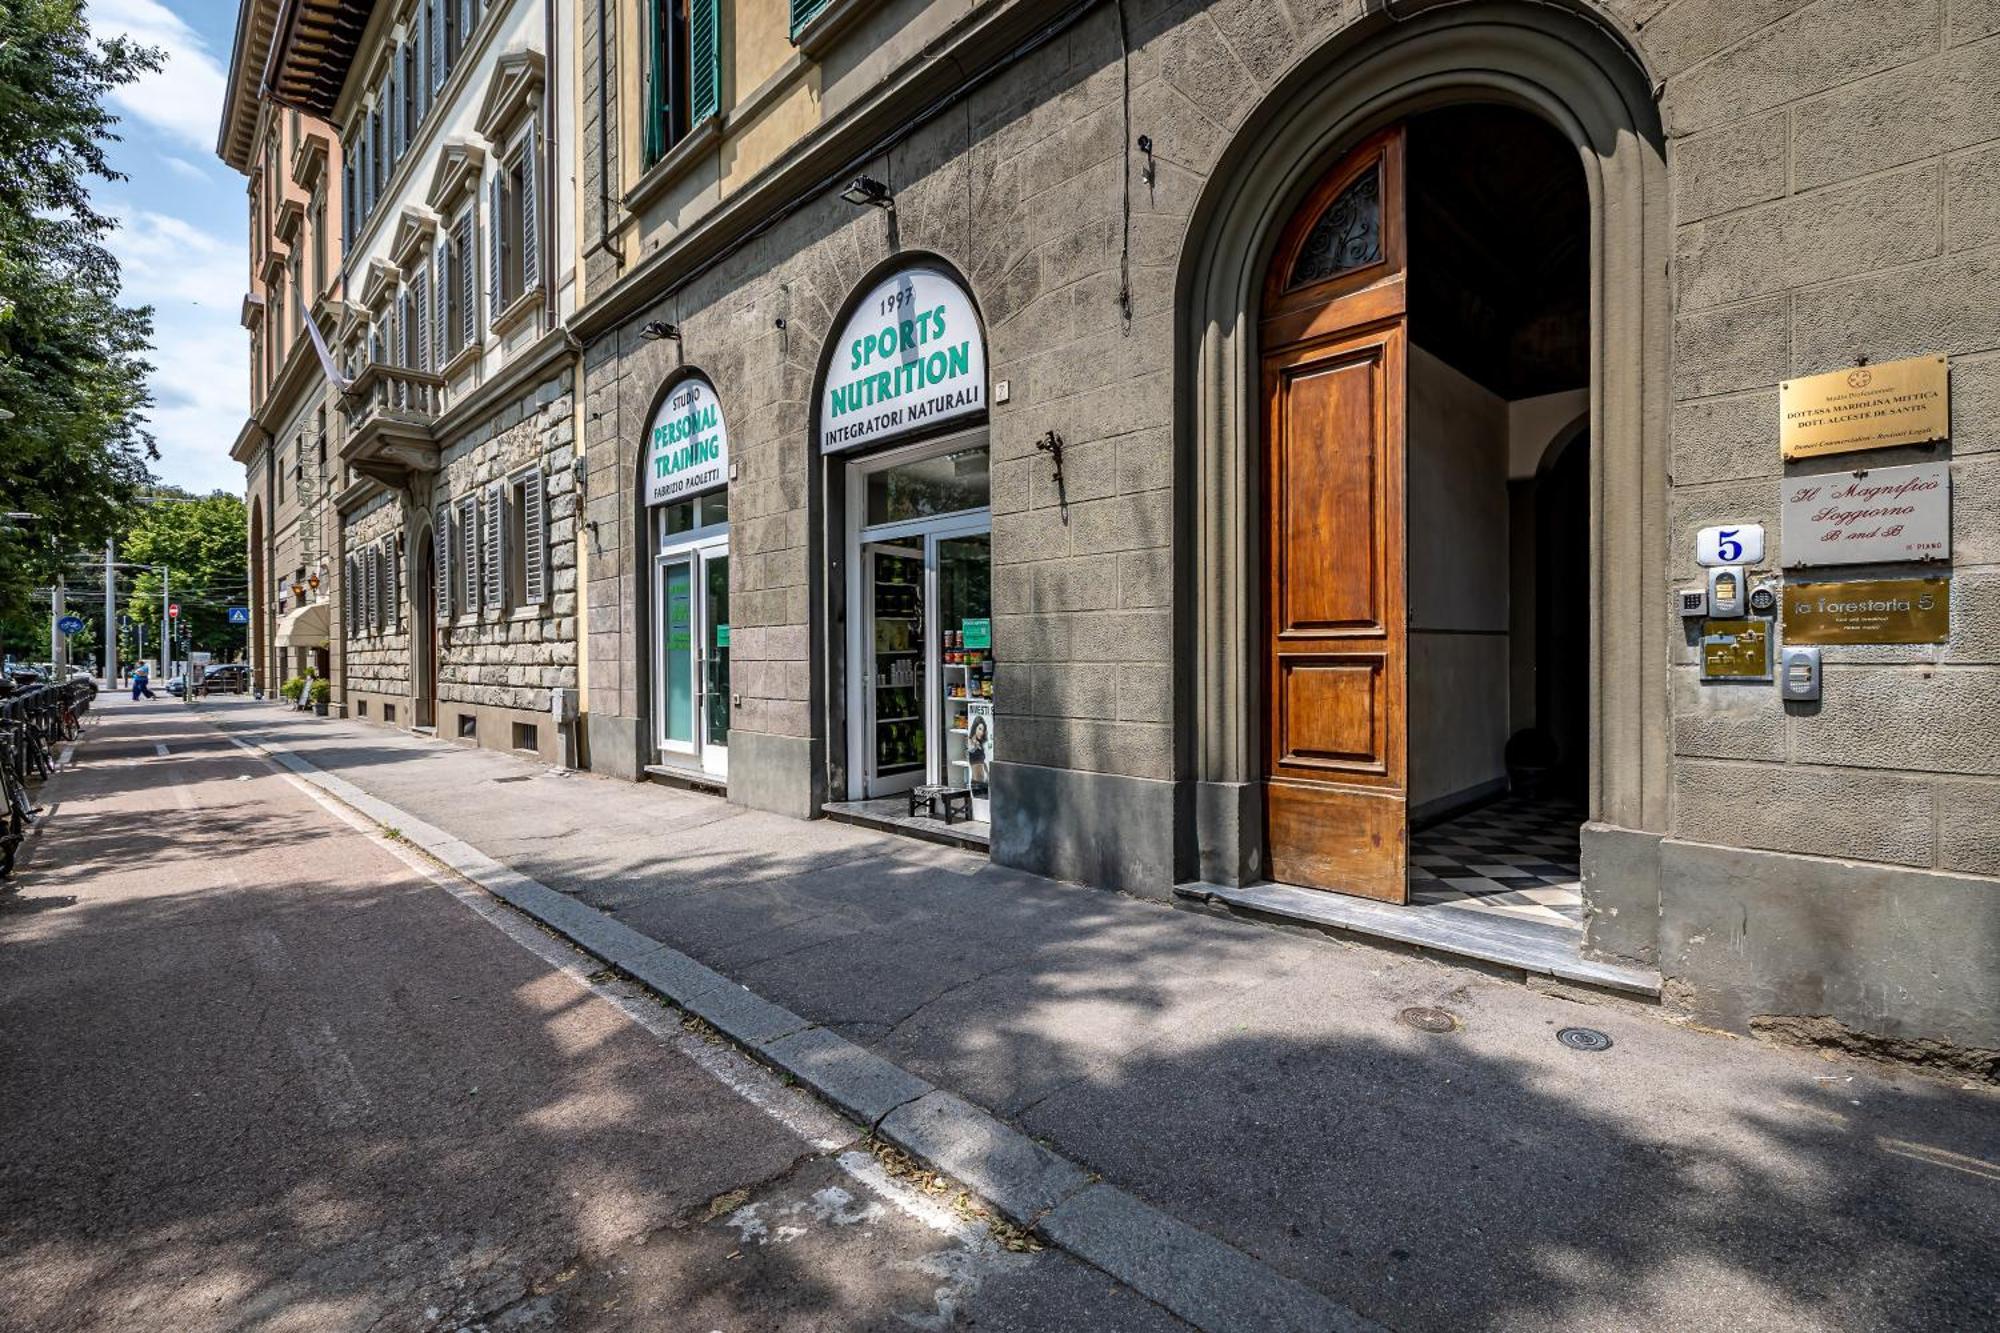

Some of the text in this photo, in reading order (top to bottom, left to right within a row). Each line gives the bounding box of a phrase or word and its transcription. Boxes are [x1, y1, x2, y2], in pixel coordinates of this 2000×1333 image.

[880, 285, 914, 316] 1997
[851, 305, 946, 371] SPORTS
[831, 341, 970, 417] NUTRITION
[673, 388, 701, 411] STUDIO
[1828, 412, 1872, 424] ALCESTE
[1873, 410, 1886, 418] DE
[1889, 403, 1927, 415] SANTIS
[1833, 399, 1890, 412] MARIOLINA
[1893, 391, 1939, 404] MITTICA
[654, 404, 718, 449] PERSONAL
[825, 385, 979, 446] INTEGRATORI NATURALI
[654, 435, 719, 479] TRAINING
[653, 468, 720, 499] FABRIZIO PAOLETTI
[1811, 505, 1916, 526] Soggiorno
[1718, 530, 1743, 562] 5
[1820, 524, 1905, 542] B and B
[1917, 593, 1936, 611] 5
